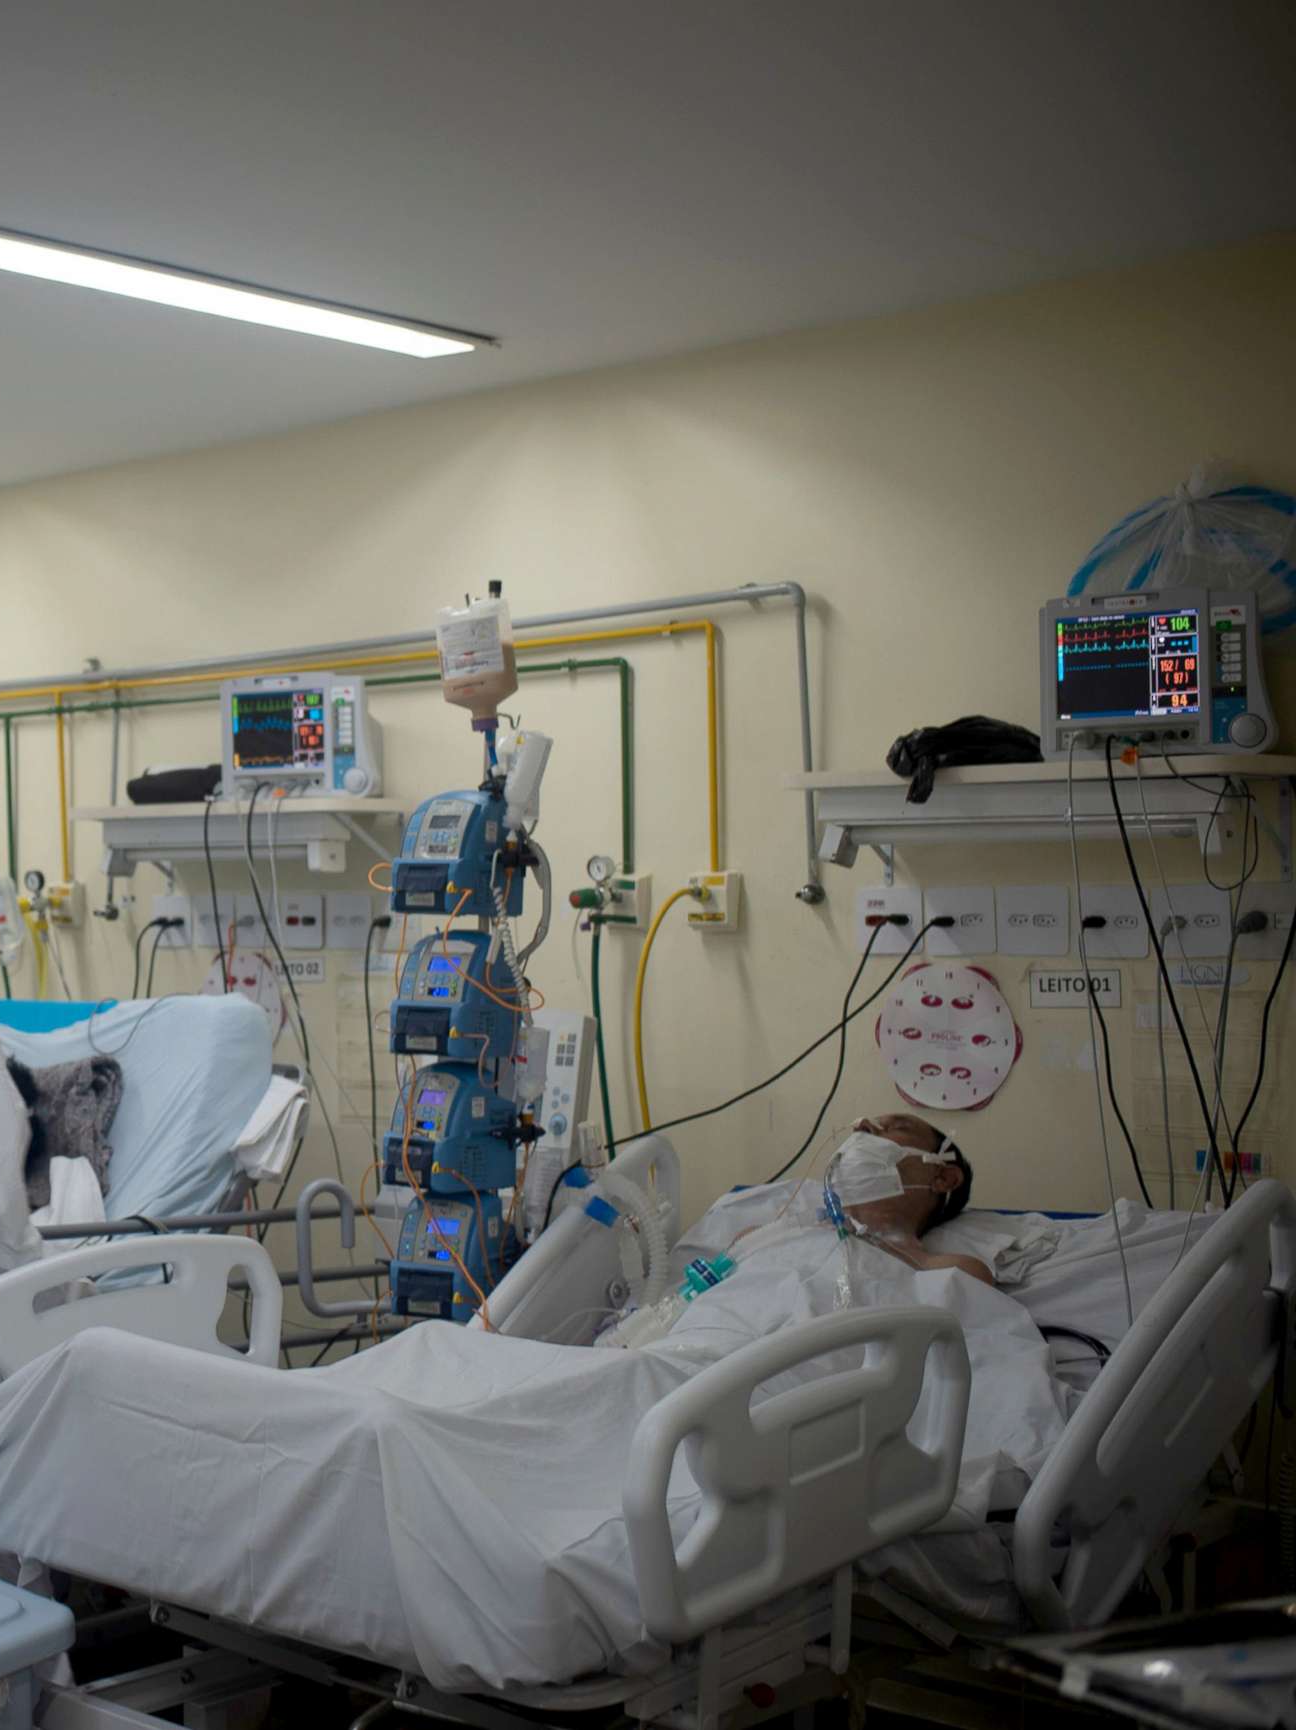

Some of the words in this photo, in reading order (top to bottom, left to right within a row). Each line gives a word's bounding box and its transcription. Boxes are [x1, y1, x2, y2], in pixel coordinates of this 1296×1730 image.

[1170, 616, 1190, 631] 104
[1171, 694, 1188, 707] 94
[1039, 977, 1086, 992] LEITO
[1090, 977, 1112, 992] 01
